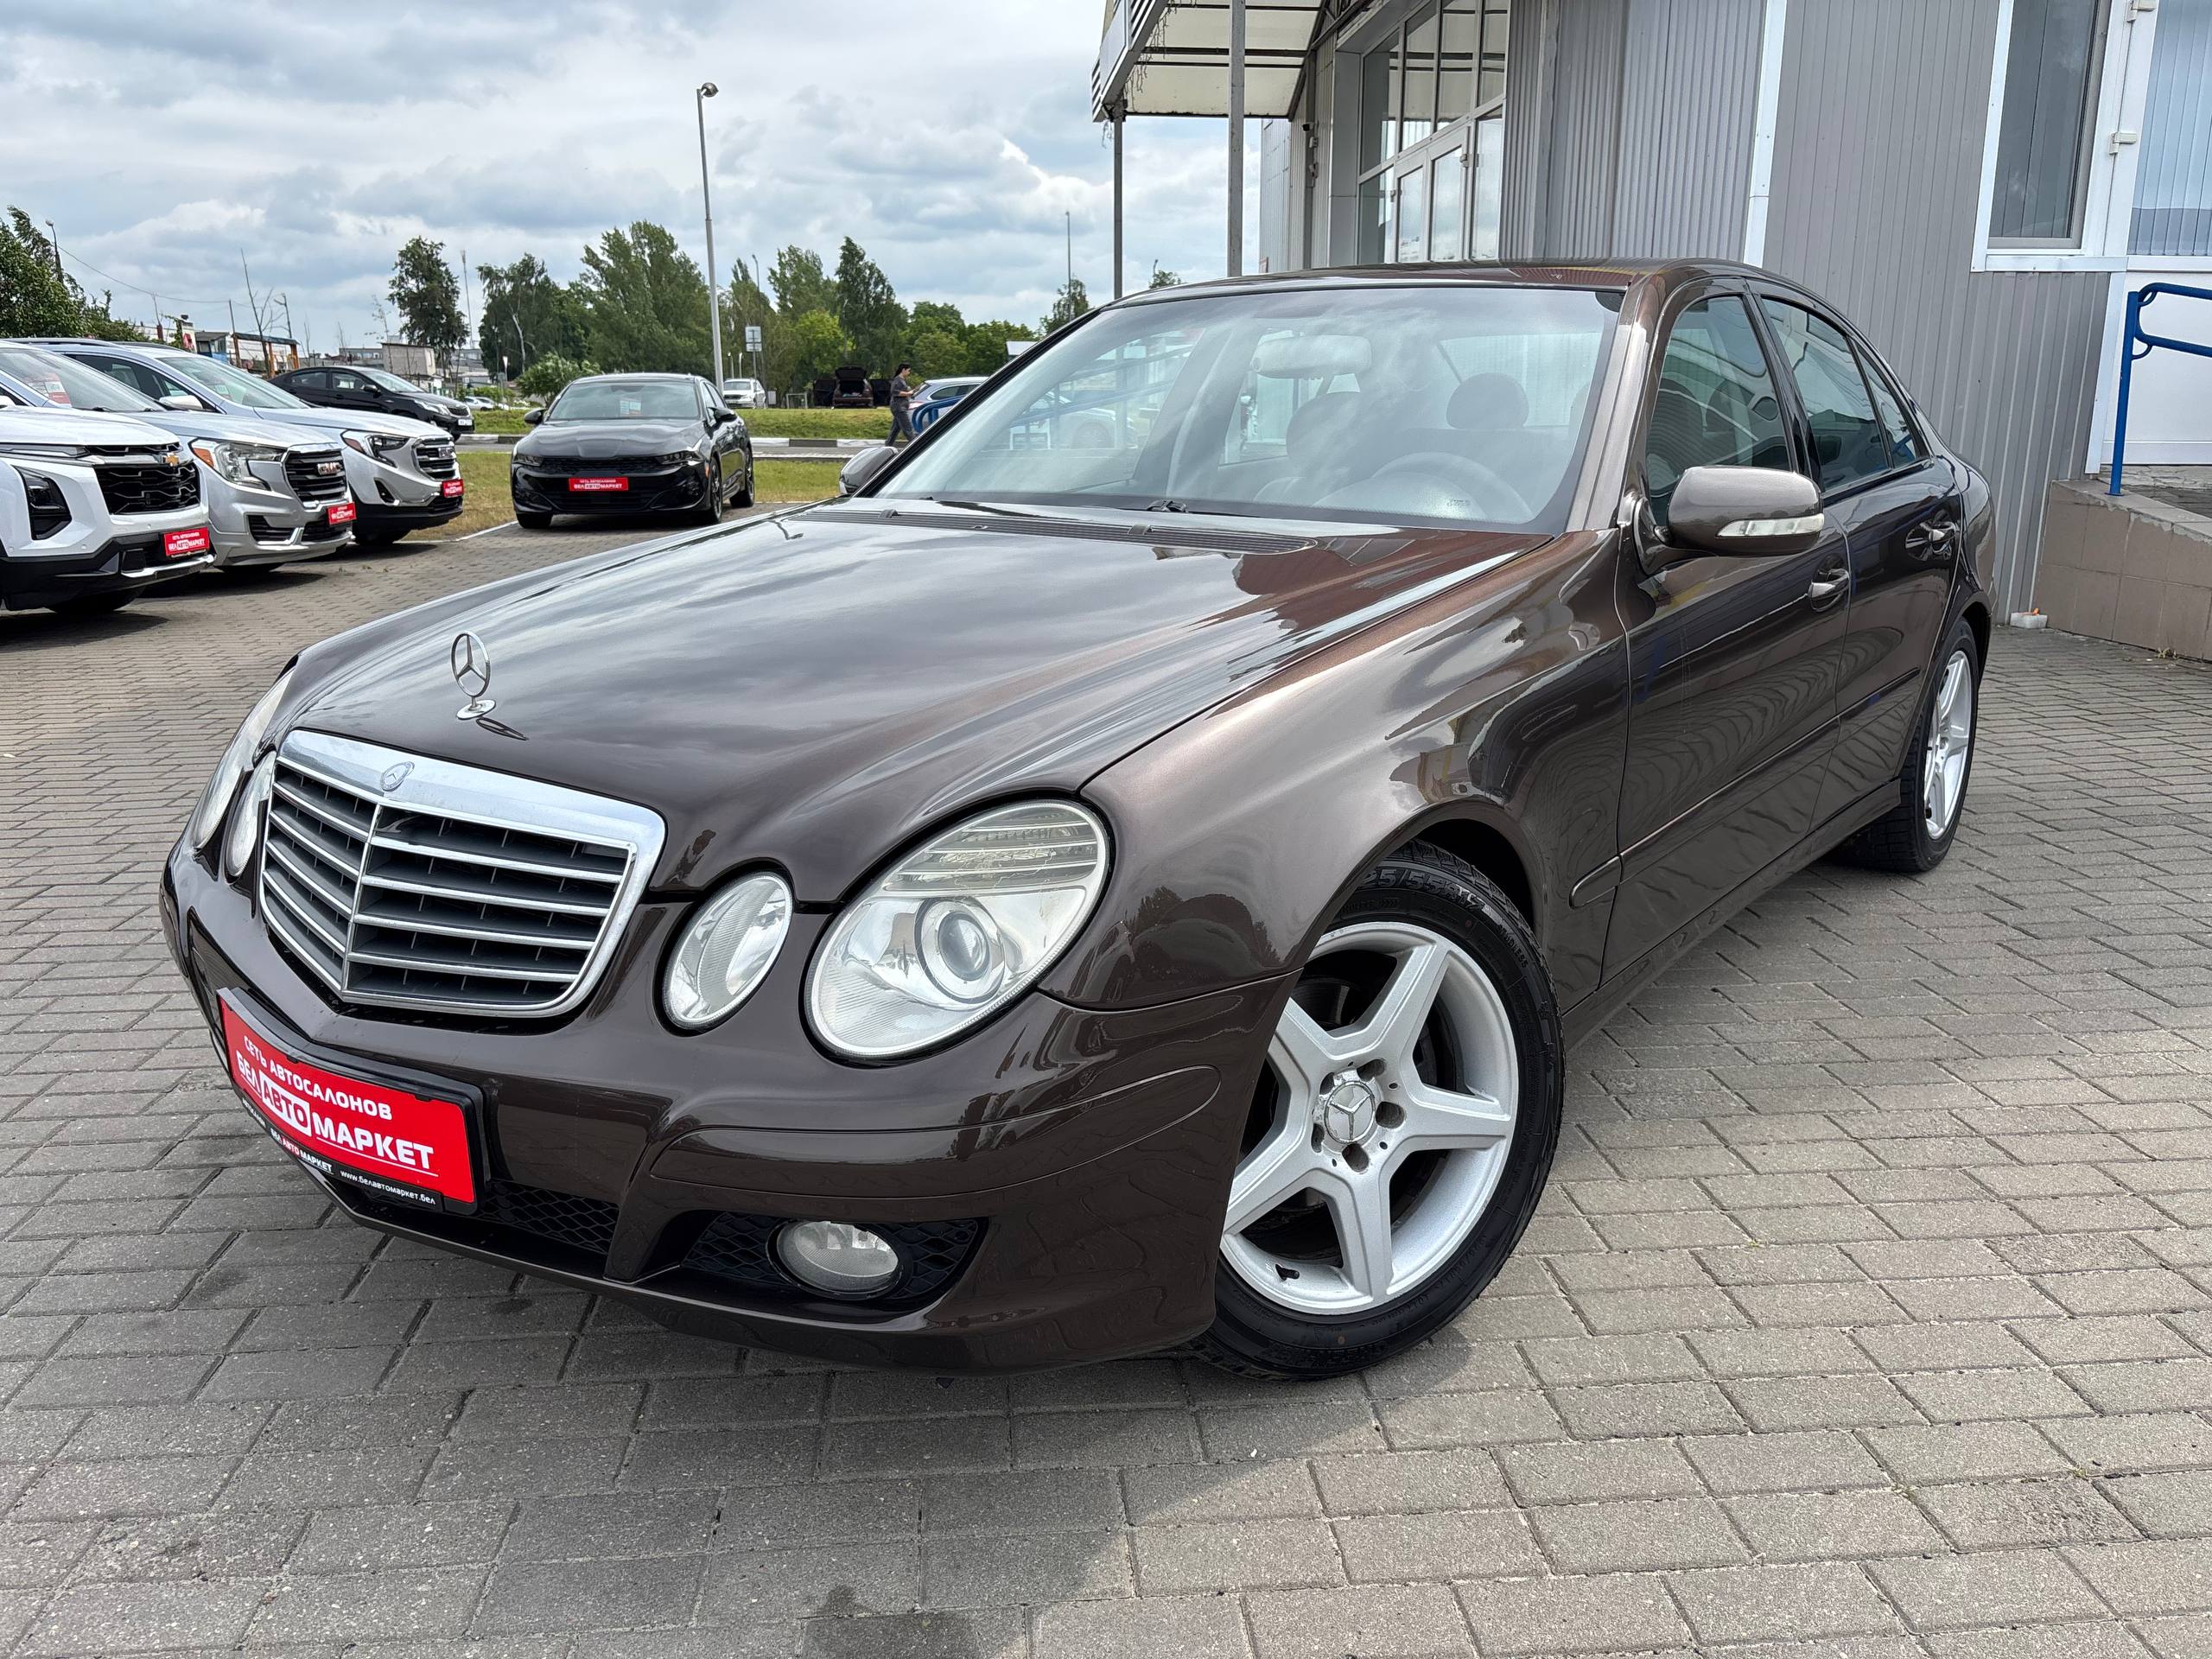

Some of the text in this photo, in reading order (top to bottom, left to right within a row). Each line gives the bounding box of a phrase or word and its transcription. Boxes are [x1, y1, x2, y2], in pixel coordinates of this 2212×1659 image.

[244, 1035, 267, 1068] СЕТЬ
[270, 1059, 392, 1121] АВТОСАЛОНОВ
[340, 1170, 436, 1205] www.белавтомаркет.бел
